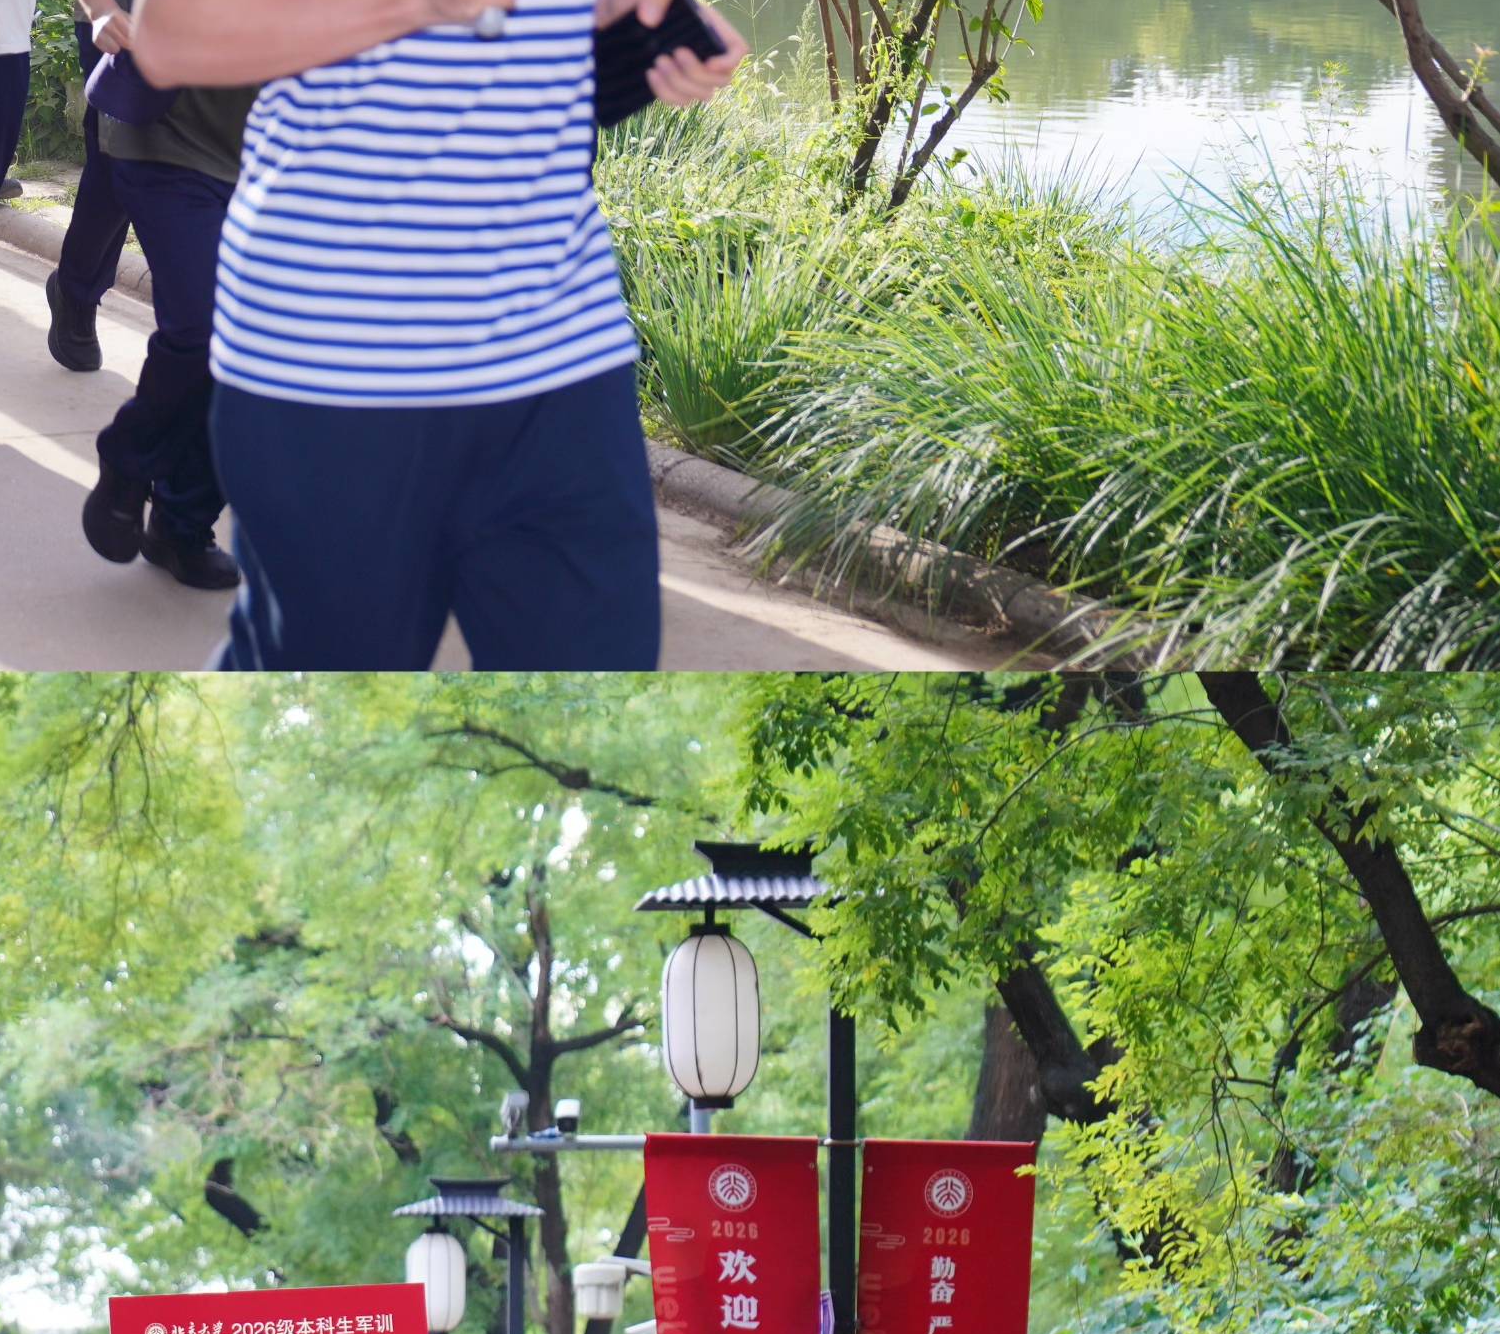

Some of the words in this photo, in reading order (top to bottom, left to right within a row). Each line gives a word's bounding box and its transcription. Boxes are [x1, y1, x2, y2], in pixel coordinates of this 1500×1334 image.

[712, 1220, 758, 1239] 2026
[923, 1227, 970, 1246] 2026
[930, 1256, 955, 1303] 勤奋
